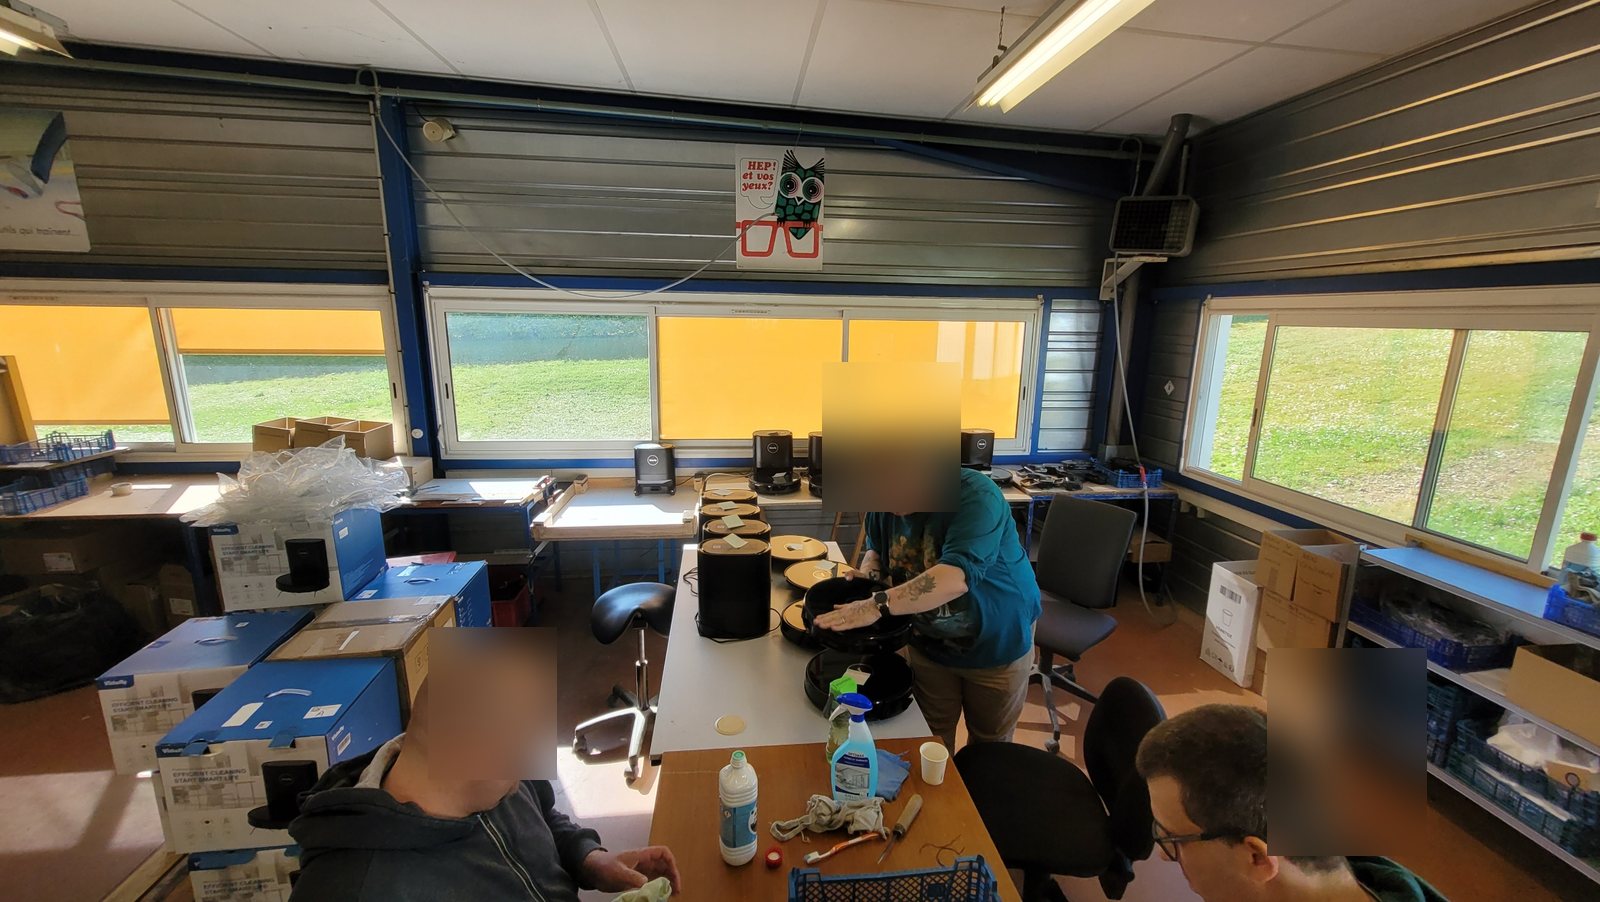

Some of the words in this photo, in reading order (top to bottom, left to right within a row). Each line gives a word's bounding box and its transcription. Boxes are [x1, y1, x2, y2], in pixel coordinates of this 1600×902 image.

[748, 161, 776, 171] HEP!
[757, 173, 774, 181] vos
[742, 182, 773, 191] yeux?
